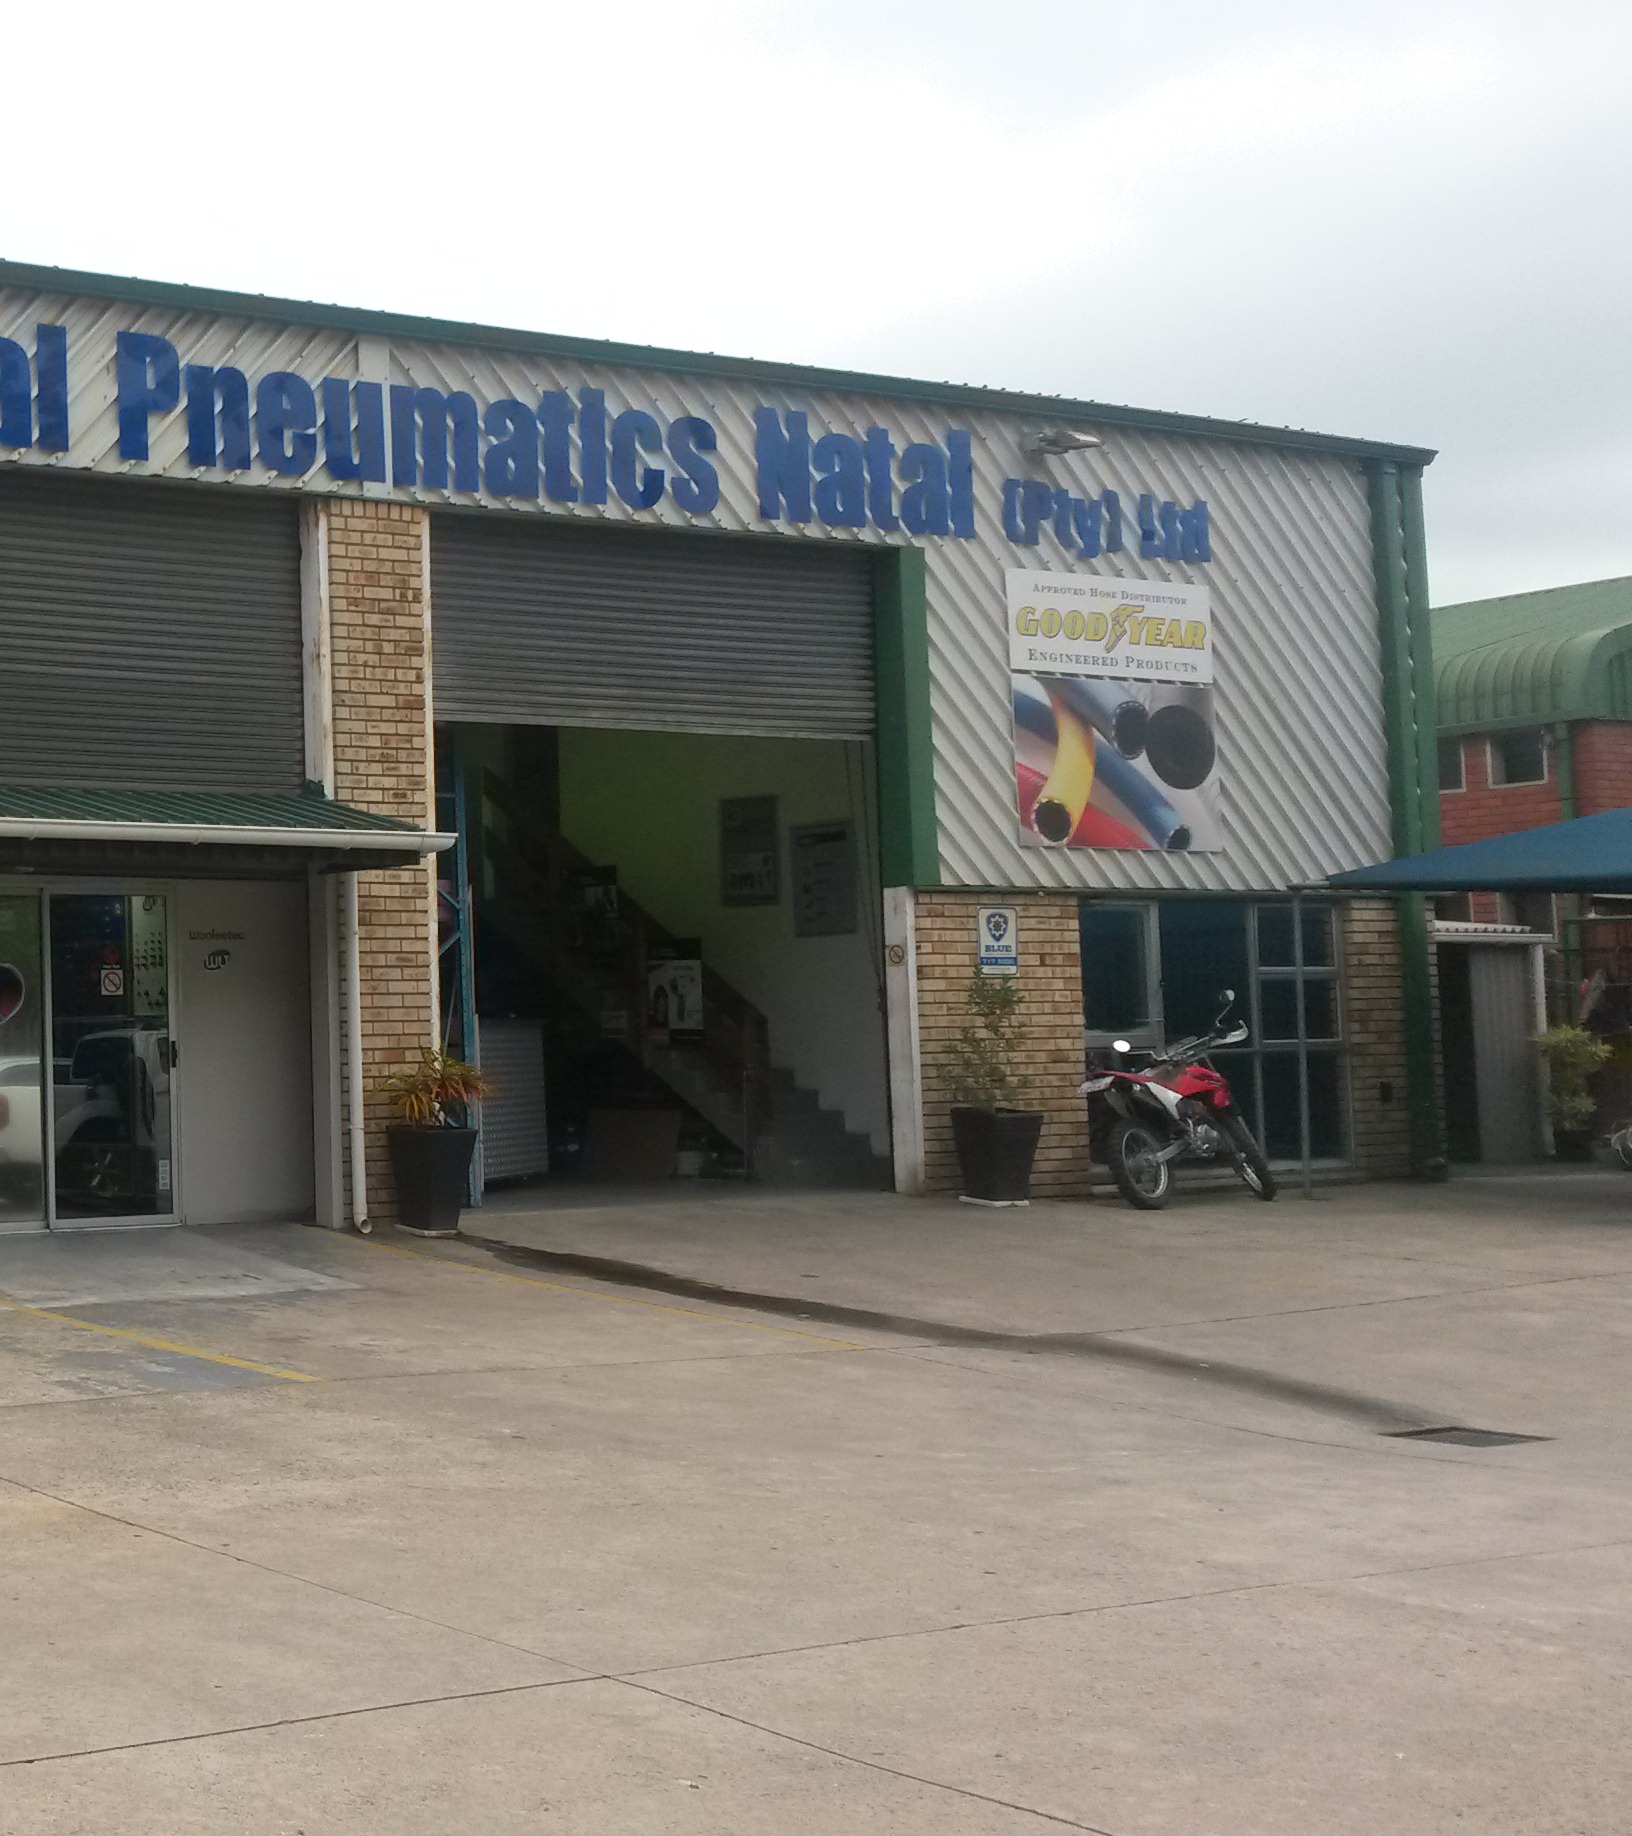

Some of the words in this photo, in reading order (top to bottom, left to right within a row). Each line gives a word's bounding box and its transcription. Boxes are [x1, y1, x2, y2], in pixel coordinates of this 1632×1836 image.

[117, 331, 718, 516] Pneumatics
[755, 406, 975, 539] Natal
[1003, 479, 1122, 558] (Pty)
[1139, 494, 1211, 562] Ltd
[1028, 649, 1118, 667] ENGINEERED
[1125, 656, 1198, 672] PRODUCTS
[985, 945, 1012, 953] BLUE
